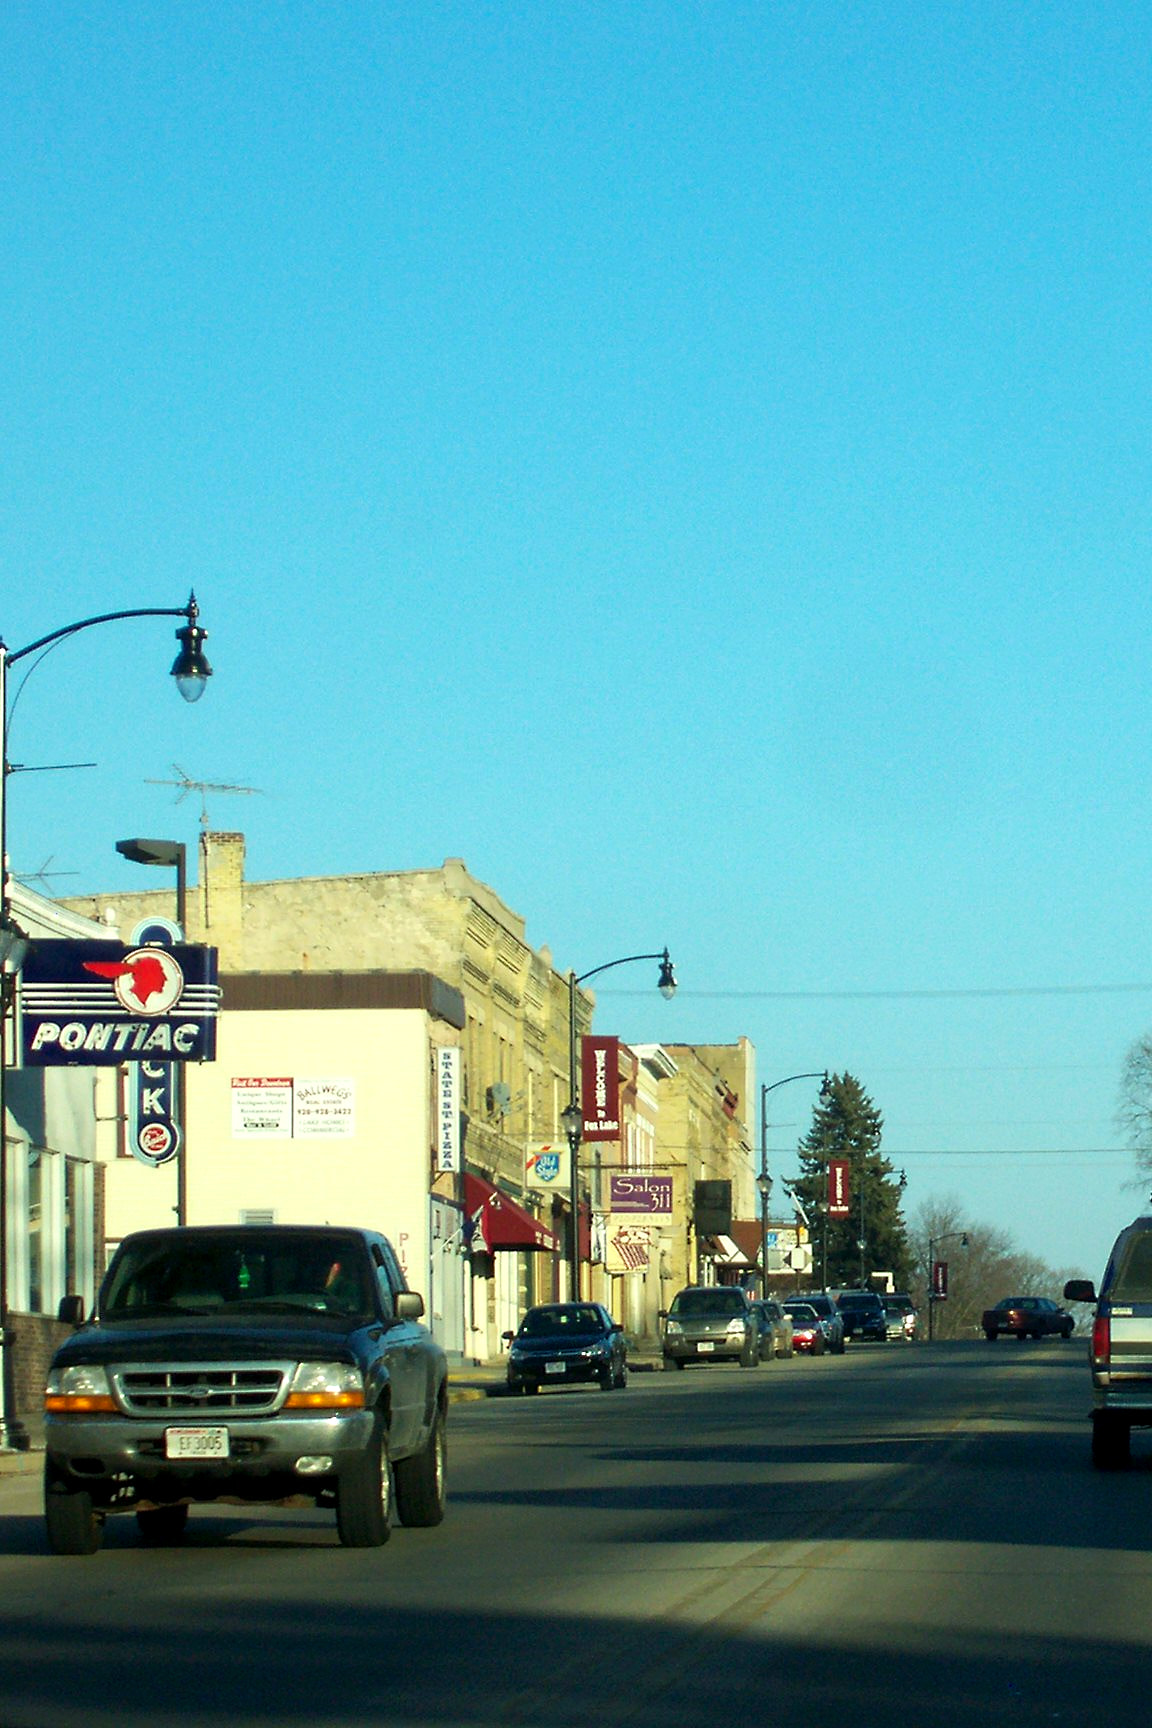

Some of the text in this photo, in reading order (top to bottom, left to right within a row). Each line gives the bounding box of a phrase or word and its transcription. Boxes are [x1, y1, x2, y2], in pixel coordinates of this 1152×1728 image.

[32, 1022, 200, 1052] PONTIAC
[594, 1049, 607, 1107] WELCOME
[442, 1052, 453, 1168] STATE ST PIZZA
[584, 1120, 619, 1131] Fox Lake
[613, 1178, 670, 1195] Salon
[650, 1193, 670, 1211] 311
